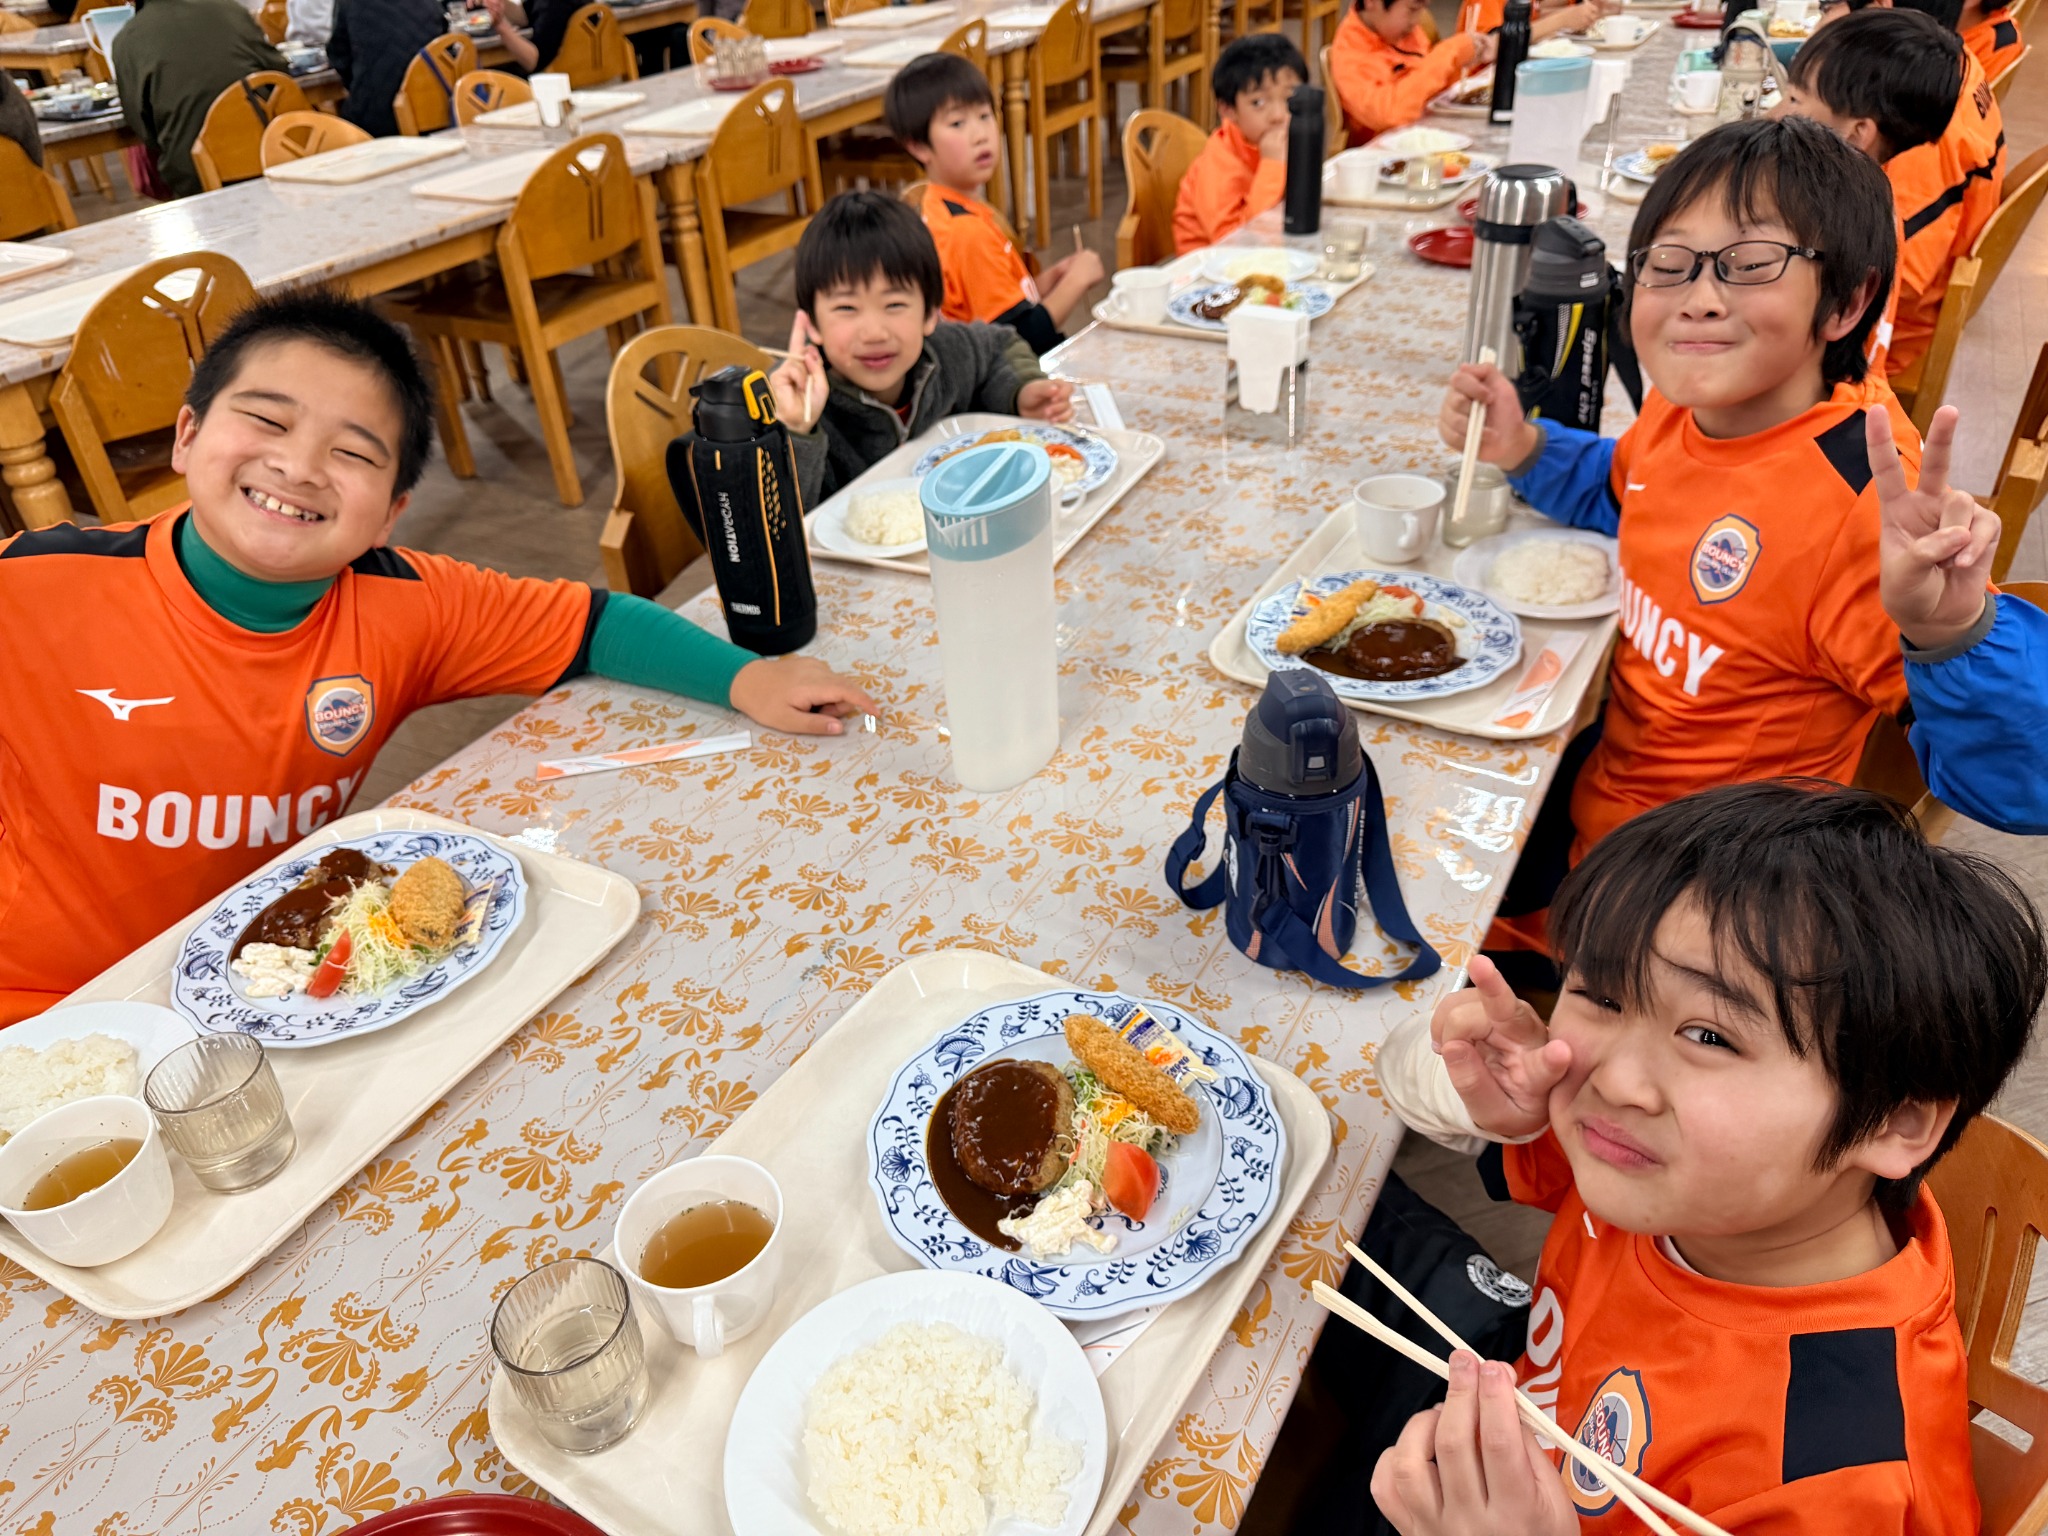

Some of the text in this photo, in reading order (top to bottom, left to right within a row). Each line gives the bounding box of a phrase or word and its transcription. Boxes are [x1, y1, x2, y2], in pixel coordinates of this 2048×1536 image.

[718, 491, 741, 563] HYDRATION
[1701, 543, 1744, 571] BOUNCY
[730, 601, 761, 616] THERMOS
[1619, 566, 1726, 698] UNCY
[314, 703, 367, 722] BOUNCY
